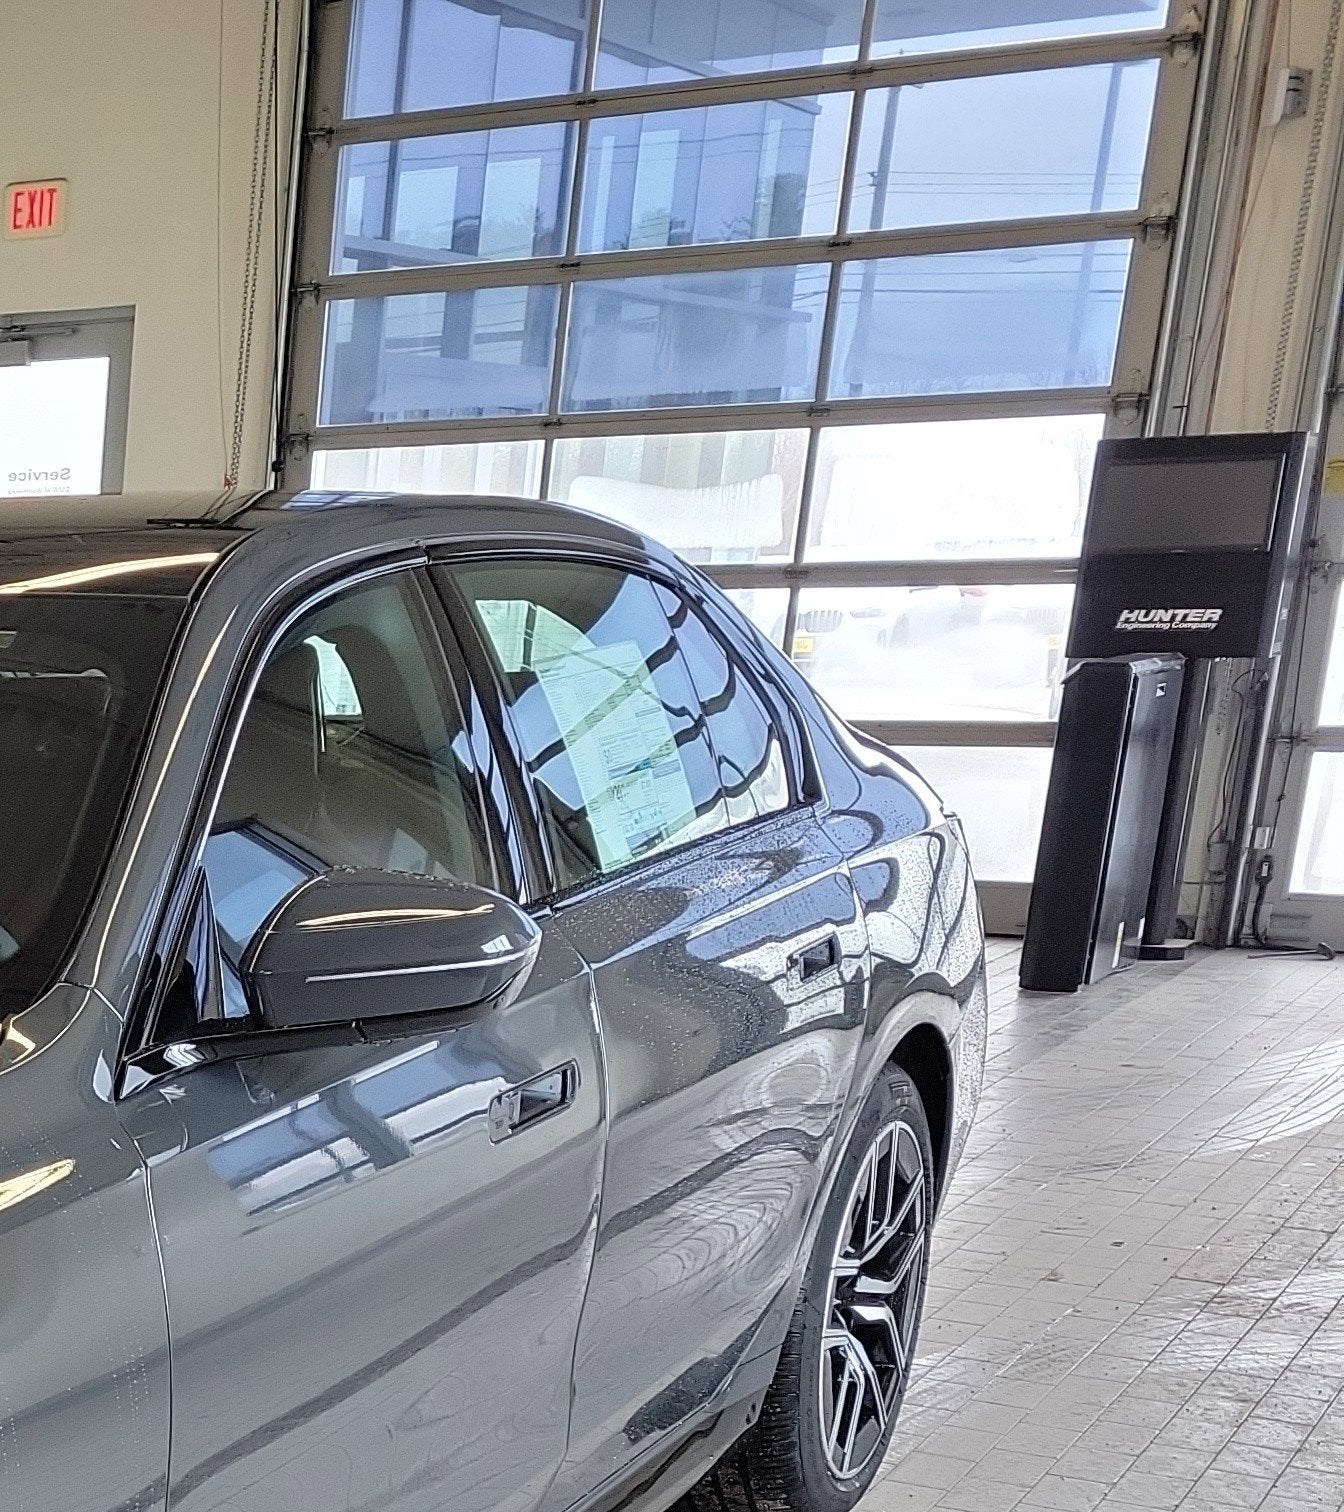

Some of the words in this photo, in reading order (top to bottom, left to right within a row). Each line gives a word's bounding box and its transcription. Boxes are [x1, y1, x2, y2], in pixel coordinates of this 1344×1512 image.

[13, 187, 57, 230] EXIT
[1118, 608, 1223, 622] HUNTER
[1115, 621, 1171, 630] Engineering
[1171, 621, 1219, 630] Company
